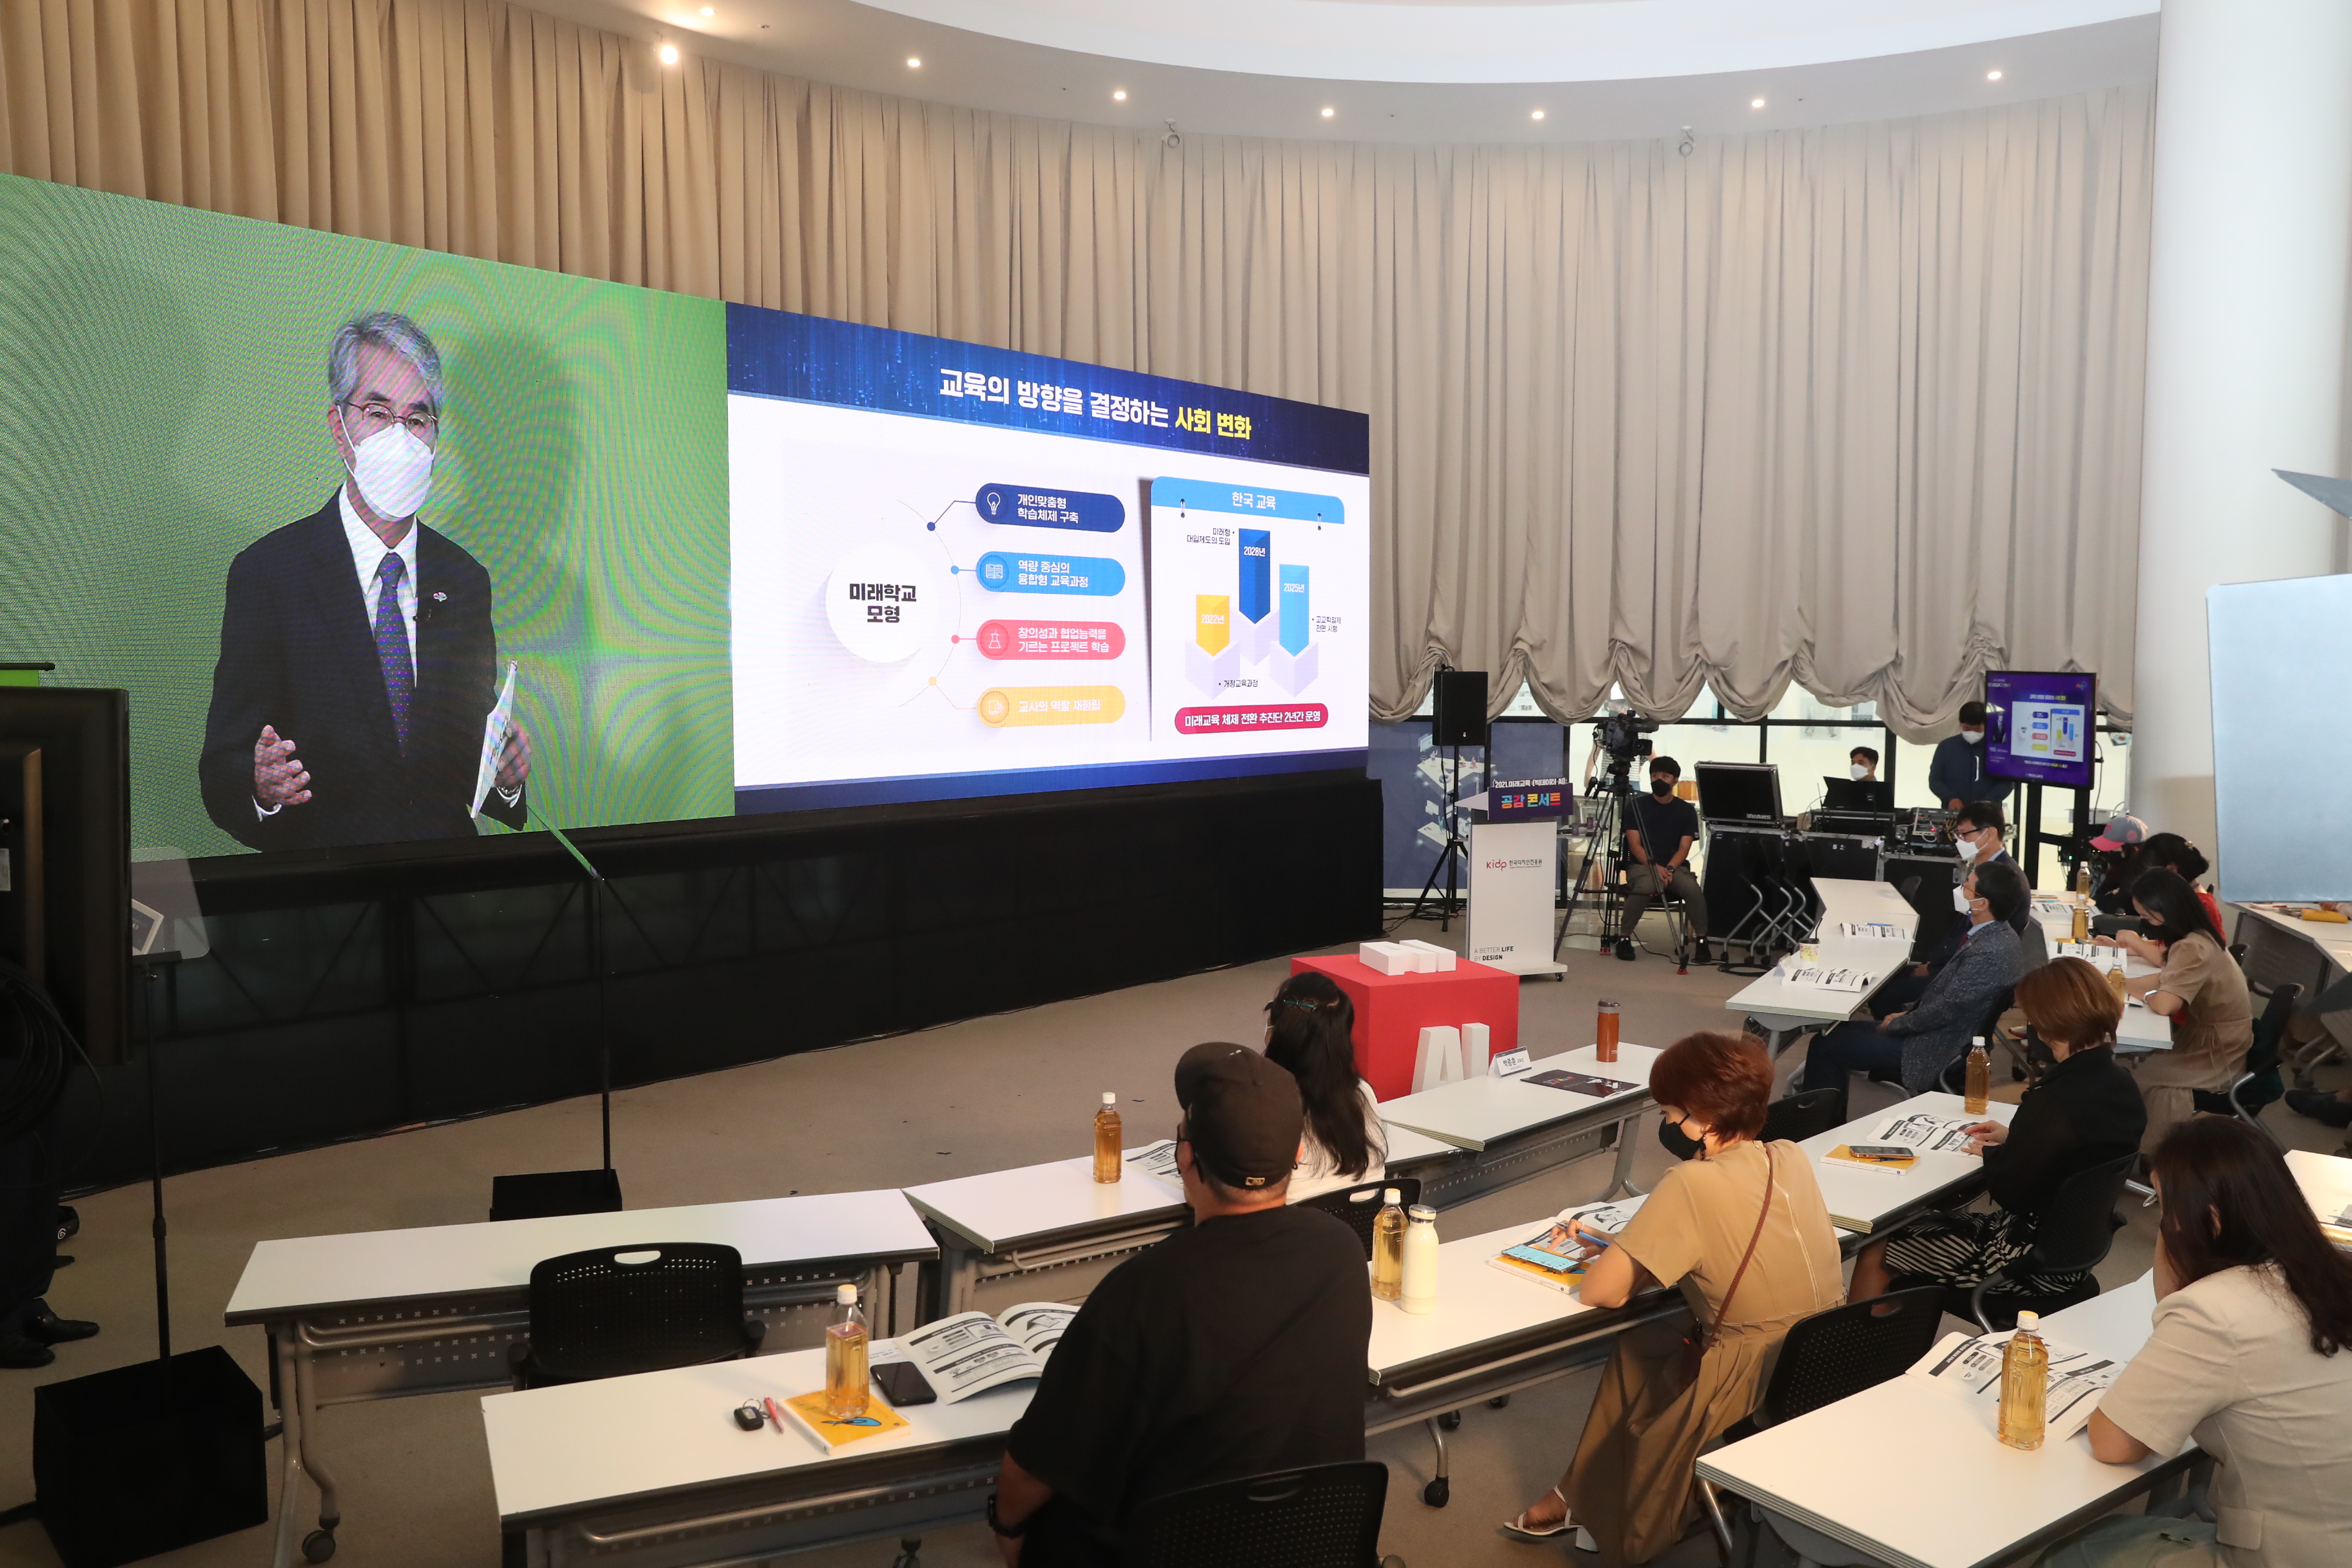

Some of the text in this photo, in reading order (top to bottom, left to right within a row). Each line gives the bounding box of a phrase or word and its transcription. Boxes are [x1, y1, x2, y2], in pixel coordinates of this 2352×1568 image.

[939, 368, 1251, 440] 교육의 방향을 결정하는 사회 변화
[1017, 494, 1066, 509] 개인맞춤형
[1232, 491, 1276, 510] 한국 교육
[1017, 507, 1079, 524] 학습체제 구축
[1213, 527, 1230, 536] 미래형
[1187, 534, 1230, 545] 대입제도의 도입
[1243, 546, 1266, 557] 2028년
[1018, 560, 1070, 573] 역량 중심의
[1018, 573, 1088, 587] 융합형 교육과정
[849, 583, 917, 602] 미래학교
[1284, 583, 1305, 593] 2025년
[867, 605, 900, 623] 모형
[1201, 614, 1224, 624] 2022년
[1316, 616, 1342, 625] 고교학점제
[1018, 627, 1106, 640] 창의성과 협업능력을
[1018, 641, 1109, 653] 기르는 프로젝트 학습
[1223, 679, 1258, 687] 개정교육과정
[1018, 699, 1101, 712] 교사의 역할 재정립
[1184, 710, 1321, 727] 미래교육 체제 전환 추진단 2년간 운영
[1501, 792, 1561, 809] 공감 콘서트
[1411, 1023, 1490, 1095] AI
